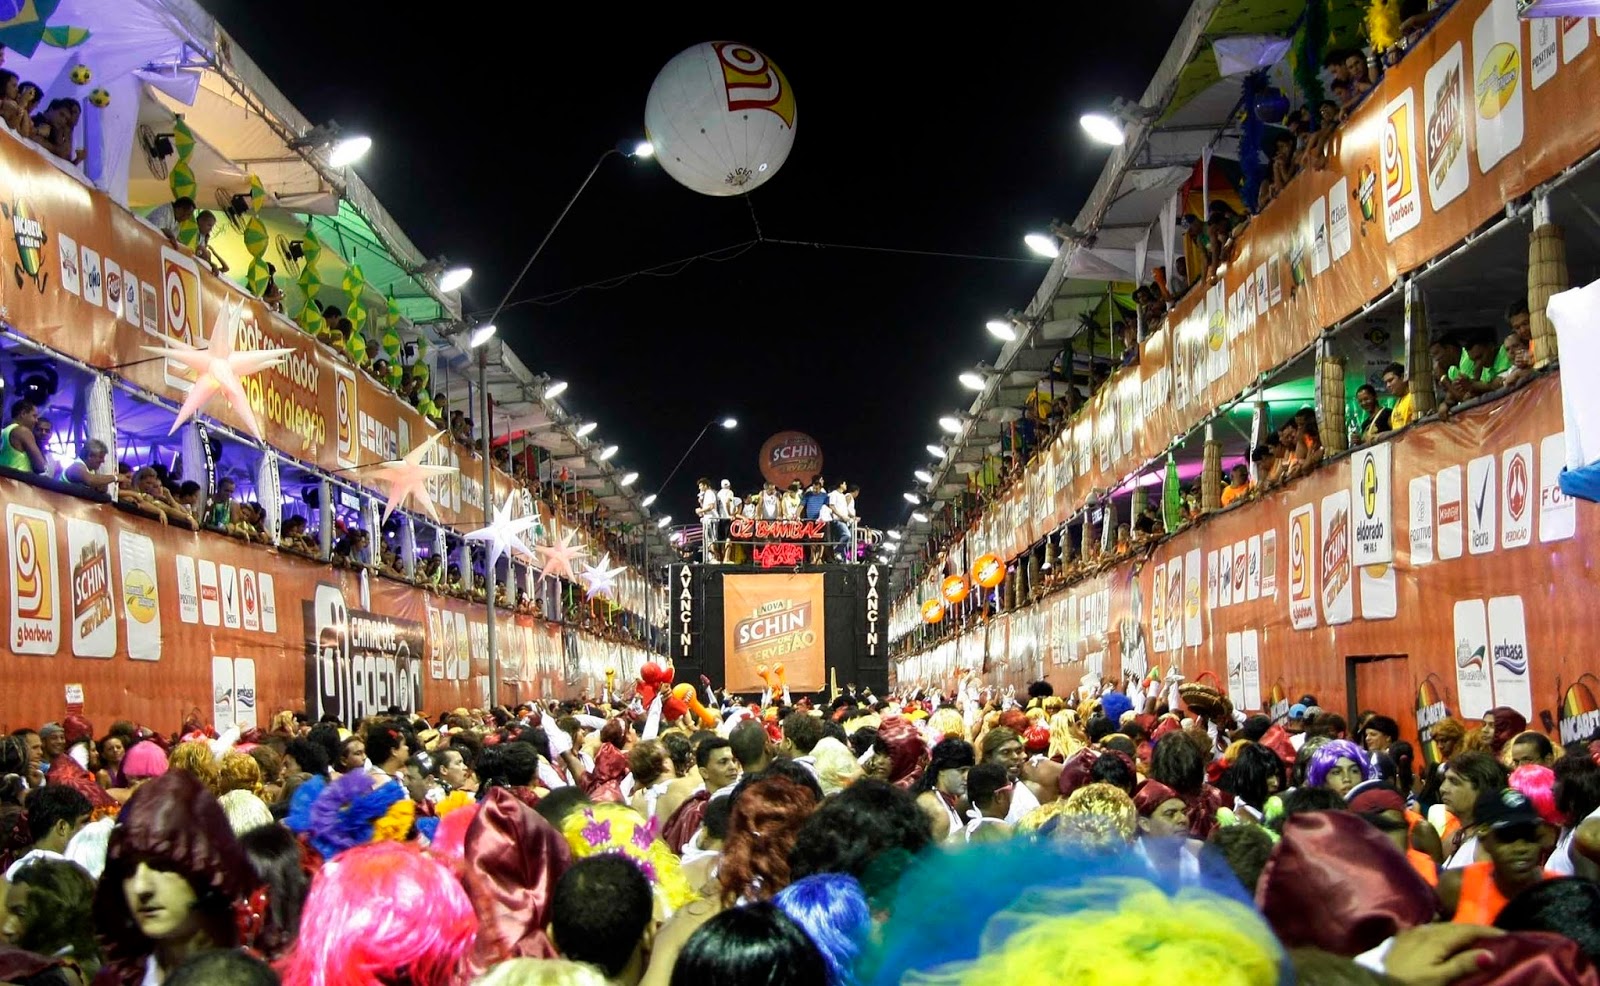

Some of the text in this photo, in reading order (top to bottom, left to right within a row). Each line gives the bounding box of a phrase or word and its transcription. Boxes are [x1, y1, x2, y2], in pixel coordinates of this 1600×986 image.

[268, 380, 281, 424] da
[285, 393, 326, 450] alegria
[773, 445, 818, 461] SCHIN
[1357, 517, 1384, 542] eldorado
[76, 558, 106, 606] SCHIN
[680, 565, 692, 656] AVANCINI
[761, 601, 784, 612] NOVA
[867, 564, 879, 656] AVANCINI
[740, 609, 804, 644] SCHIN
[1494, 638, 1523, 660] embasa
[1560, 710, 1599, 745] MICARET
